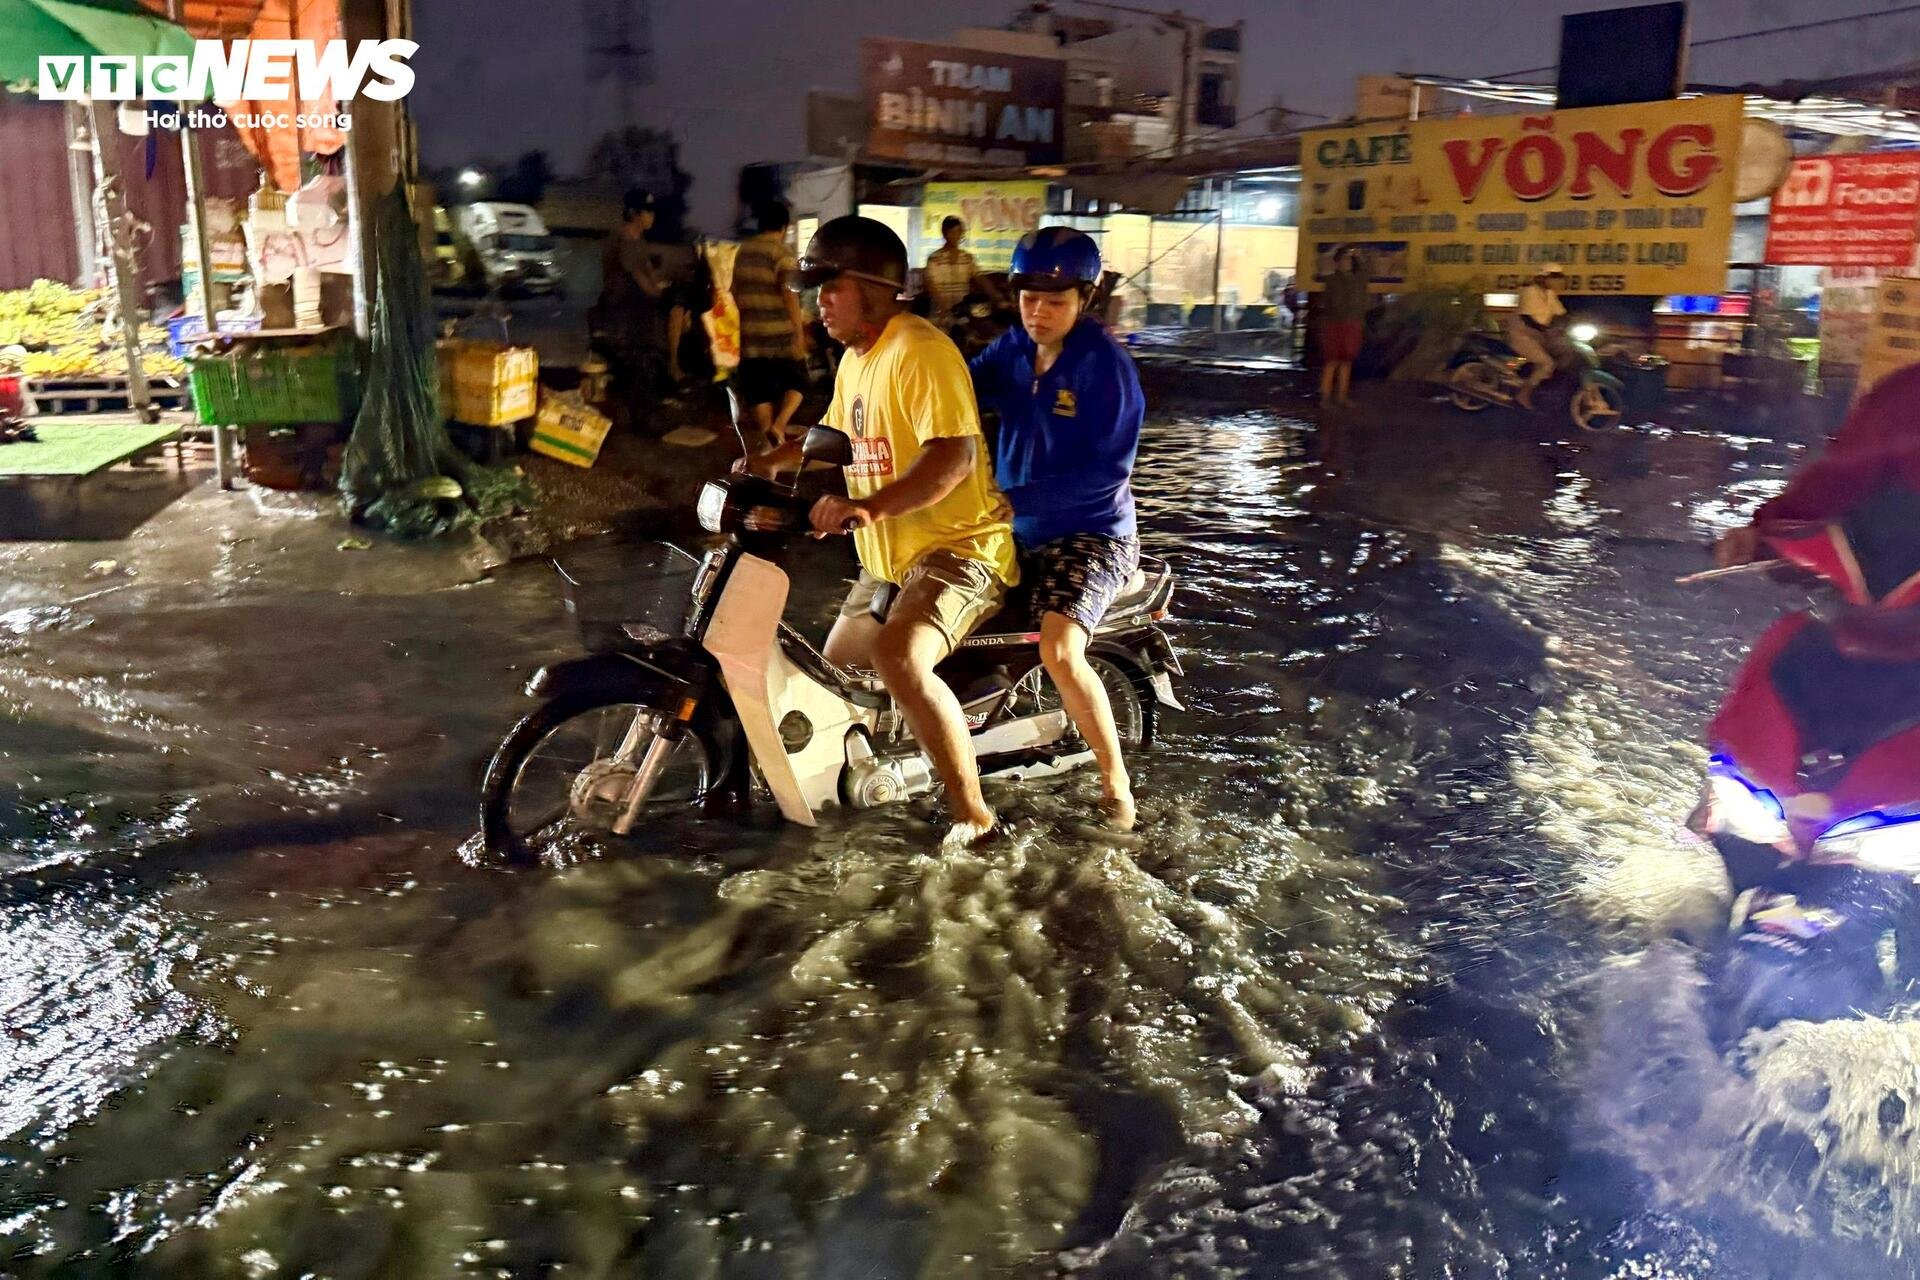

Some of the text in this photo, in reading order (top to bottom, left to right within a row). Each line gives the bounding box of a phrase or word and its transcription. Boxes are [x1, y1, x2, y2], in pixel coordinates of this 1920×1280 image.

[996, 104, 1055, 143] AN
[1442, 116, 1723, 204] VÕNG
[1837, 179, 1920, 206] Food
[963, 638, 1005, 647] HONDA
